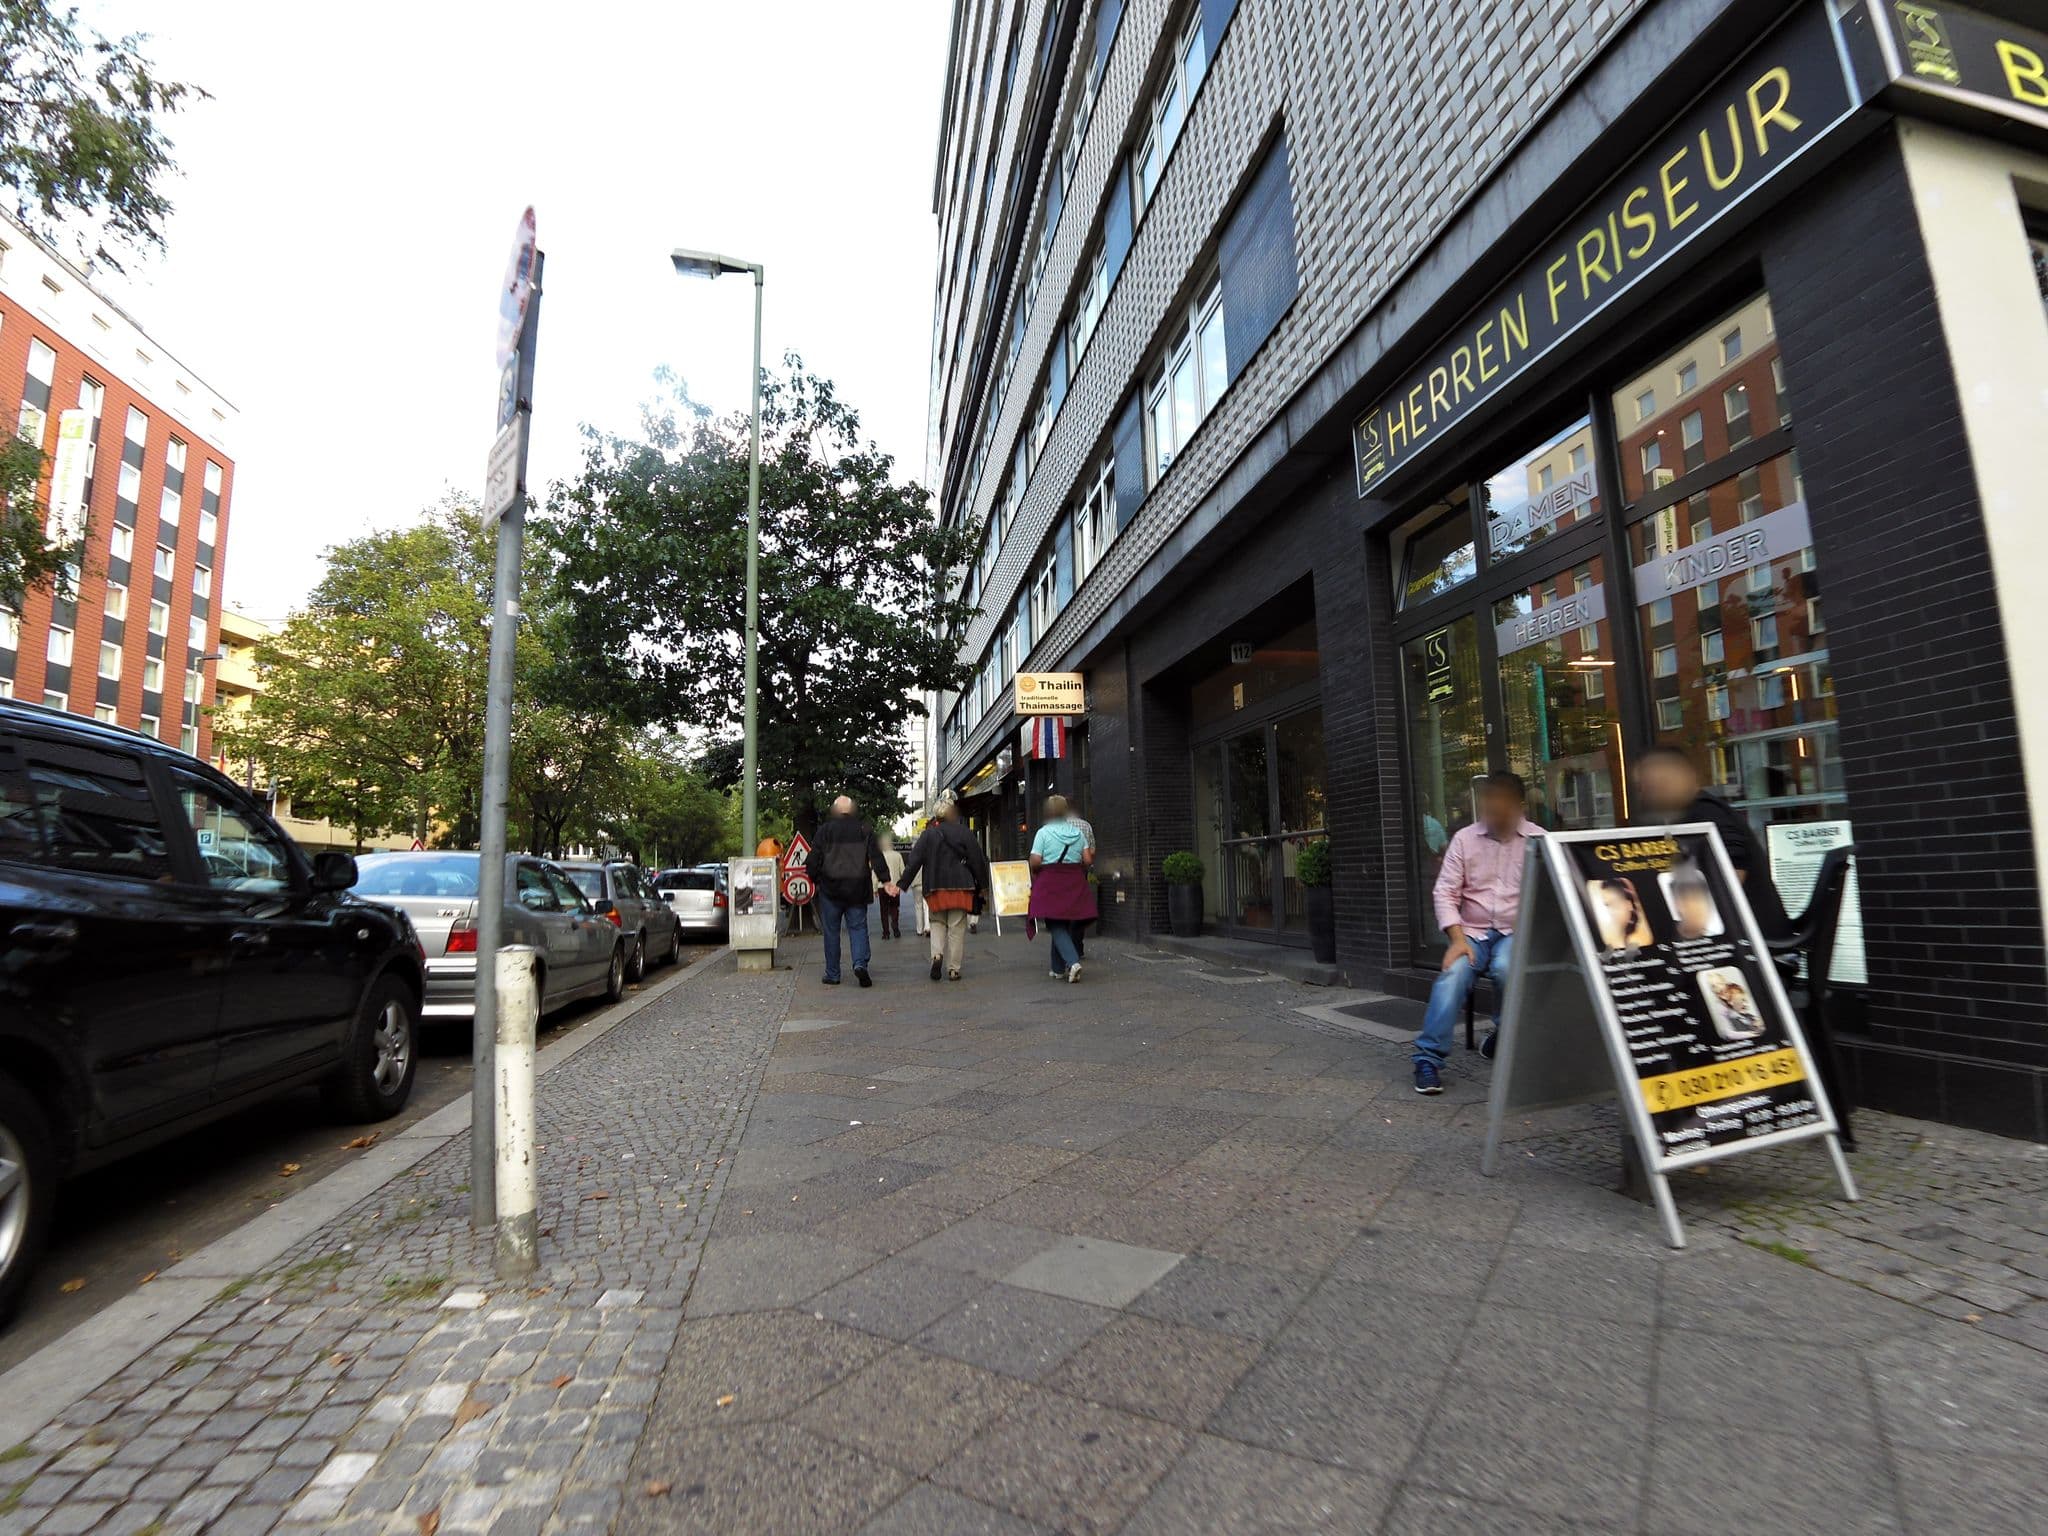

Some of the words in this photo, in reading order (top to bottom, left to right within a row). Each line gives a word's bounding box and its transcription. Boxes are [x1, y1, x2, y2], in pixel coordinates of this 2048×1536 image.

[1386, 292, 1530, 457] HERREN
[1545, 65, 1804, 326] FRISEUR
[1491, 472, 1593, 548] DAMEN
[1664, 528, 1769, 590] KINDER
[1514, 597, 1590, 647] HERREN
[1233, 646, 1250, 660] 112
[1038, 680, 1082, 691] Thailin
[1019, 702, 1083, 711] Thaimassage
[1594, 845, 1621, 861] CS
[789, 881, 808, 898] 30
[1679, 1075, 1713, 1098] 030
[1712, 1068, 1745, 1090] 210
